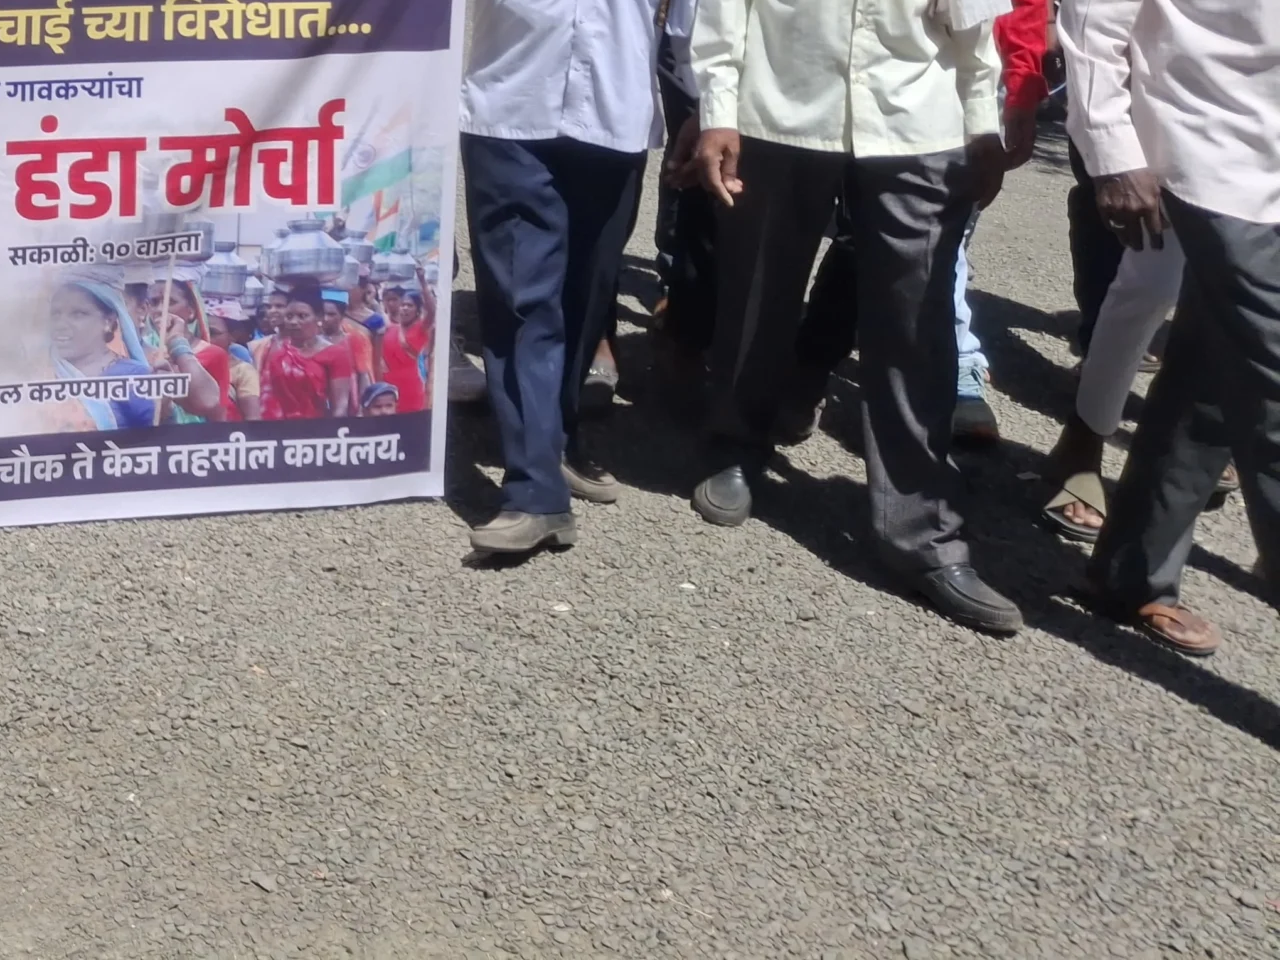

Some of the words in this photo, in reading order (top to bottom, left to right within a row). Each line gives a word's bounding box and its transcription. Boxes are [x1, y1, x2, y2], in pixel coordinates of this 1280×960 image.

[82, 5, 153, 42] च्या
[6, 114, 147, 222] हंडा
[159, 98, 345, 207] मोर्चा
[8, 236, 95, 265] सकाळी:
[101, 244, 130, 261] १०
[136, 232, 202, 257] वाजता
[28, 376, 128, 403] करण्यात
[131, 375, 189, 398] यावा
[72, 442, 95, 480] ते
[101, 441, 161, 476] केज
[166, 432, 275, 476] तहसील
[283, 427, 406, 467] कार्यलय.
